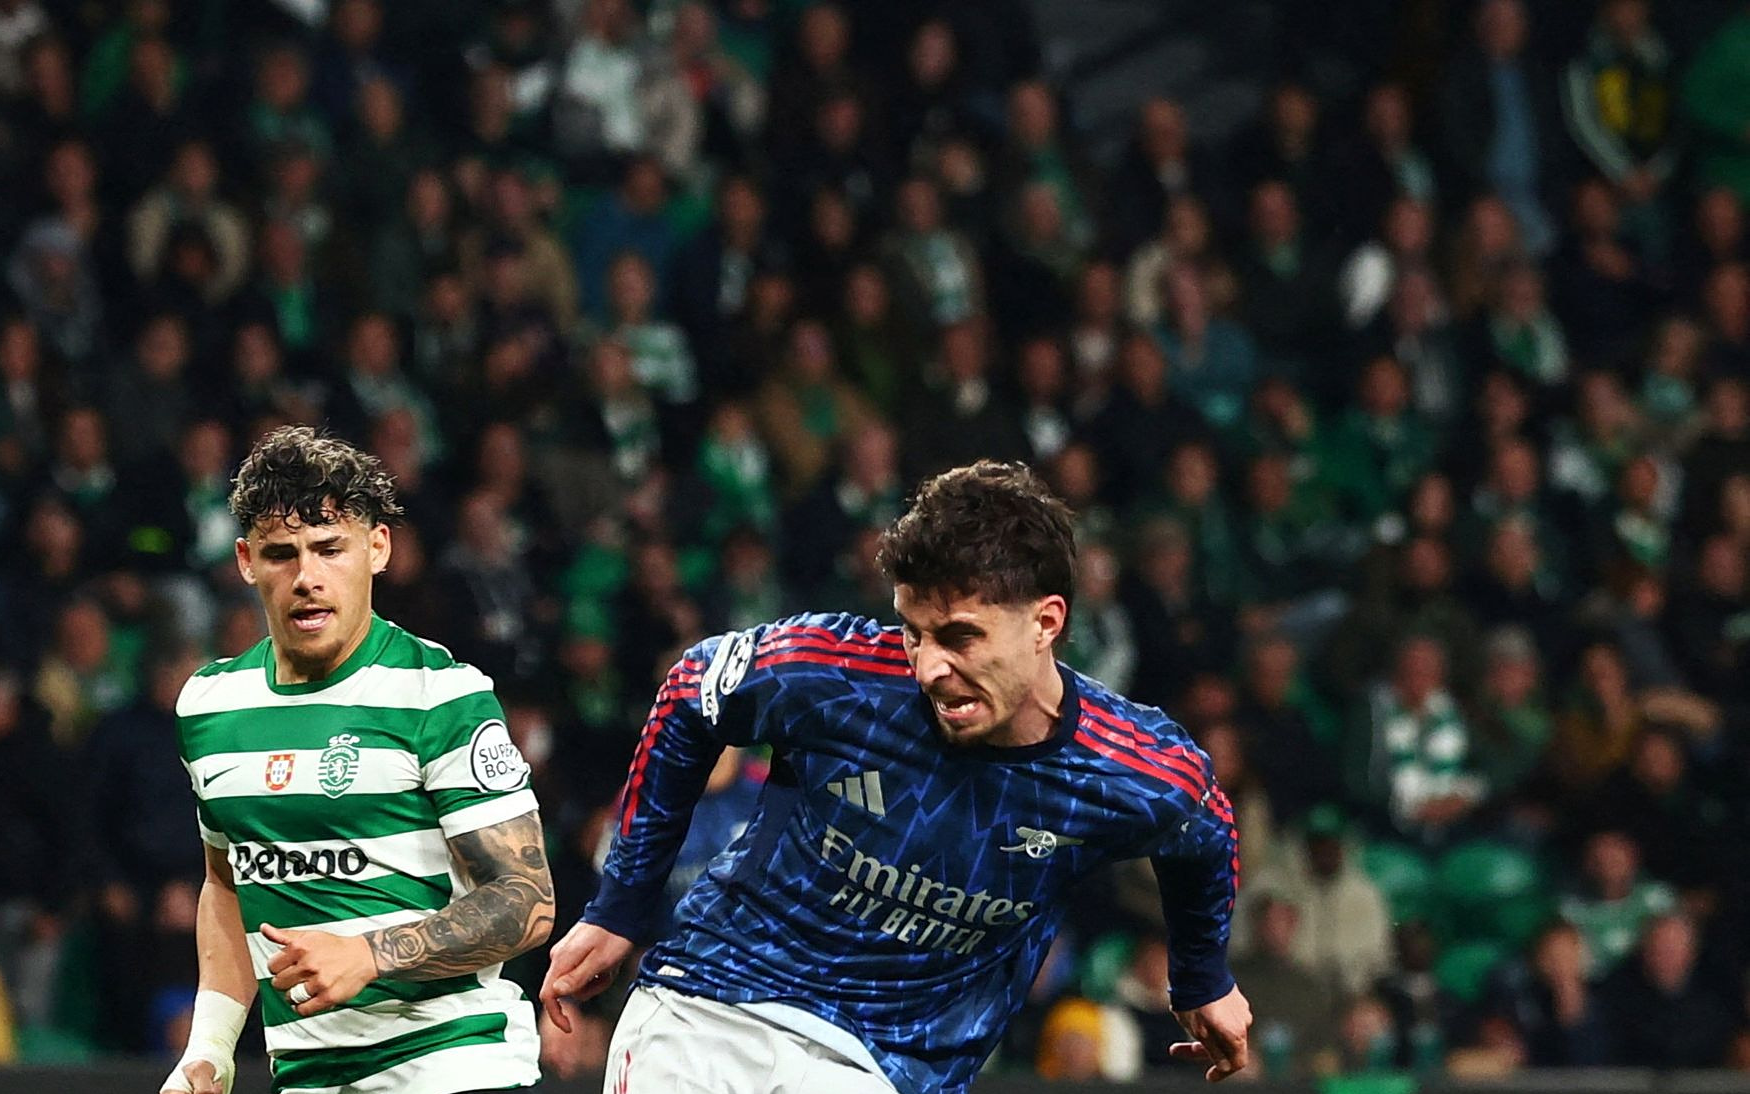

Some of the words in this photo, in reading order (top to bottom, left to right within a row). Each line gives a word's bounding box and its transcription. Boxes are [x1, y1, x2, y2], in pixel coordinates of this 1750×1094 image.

[329, 733, 361, 747] SCP
[821, 823, 1034, 926] Emirates
[829, 884, 883, 921] FLY
[880, 907, 986, 955] BETTER
